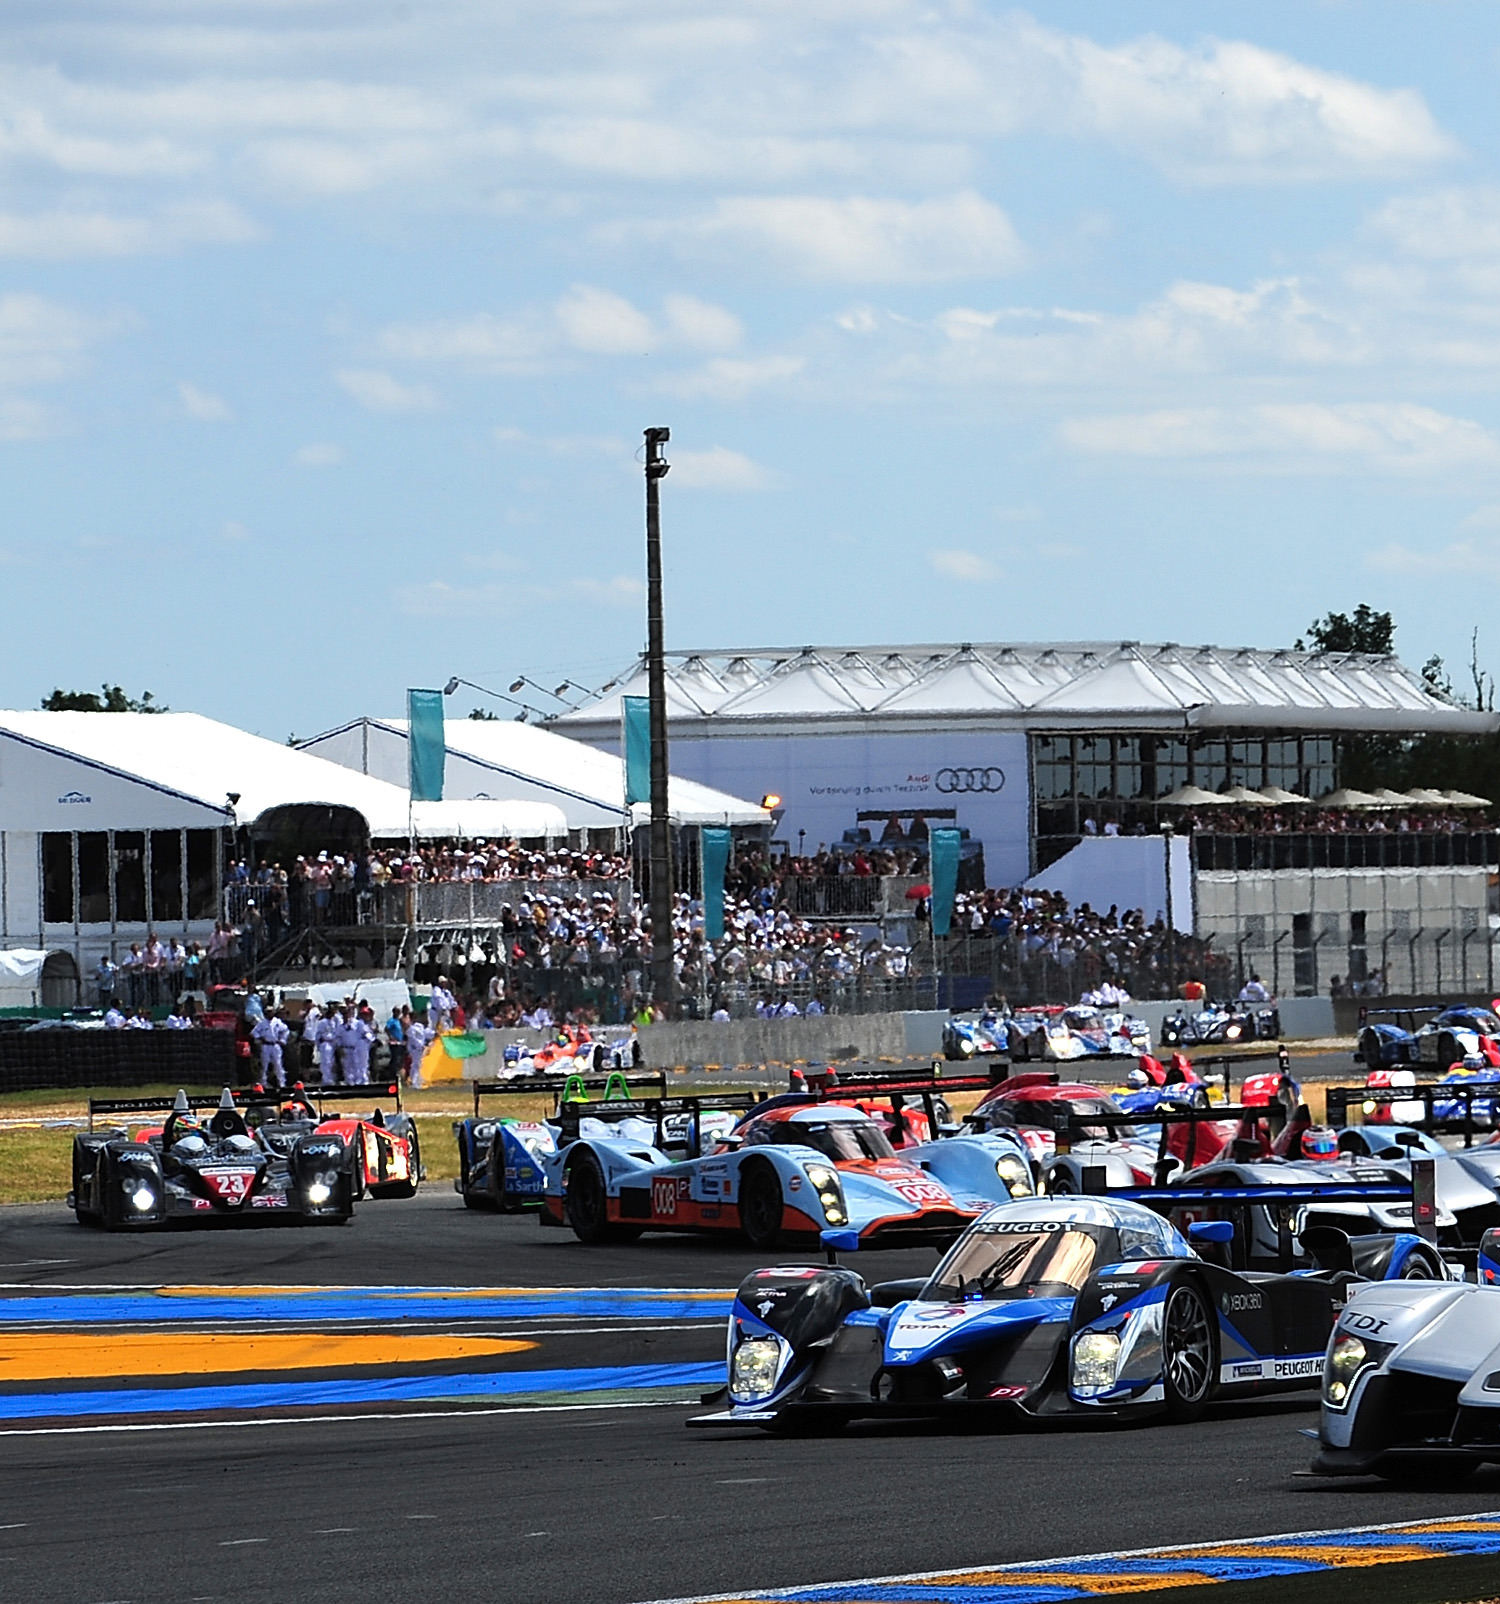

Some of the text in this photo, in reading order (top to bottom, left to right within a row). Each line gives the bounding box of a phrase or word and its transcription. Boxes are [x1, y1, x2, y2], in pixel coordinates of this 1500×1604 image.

[217, 1175, 245, 1193] 23
[901, 1183, 947, 1201] 008
[194, 1199, 211, 1209] P1
[653, 1182, 675, 1215] 008
[970, 1222, 1077, 1234] PEUGEOT
[1344, 1312, 1389, 1334] TDI
[1274, 1361, 1313, 1377] PEUGEOT
[993, 1387, 1022, 1397] P1
